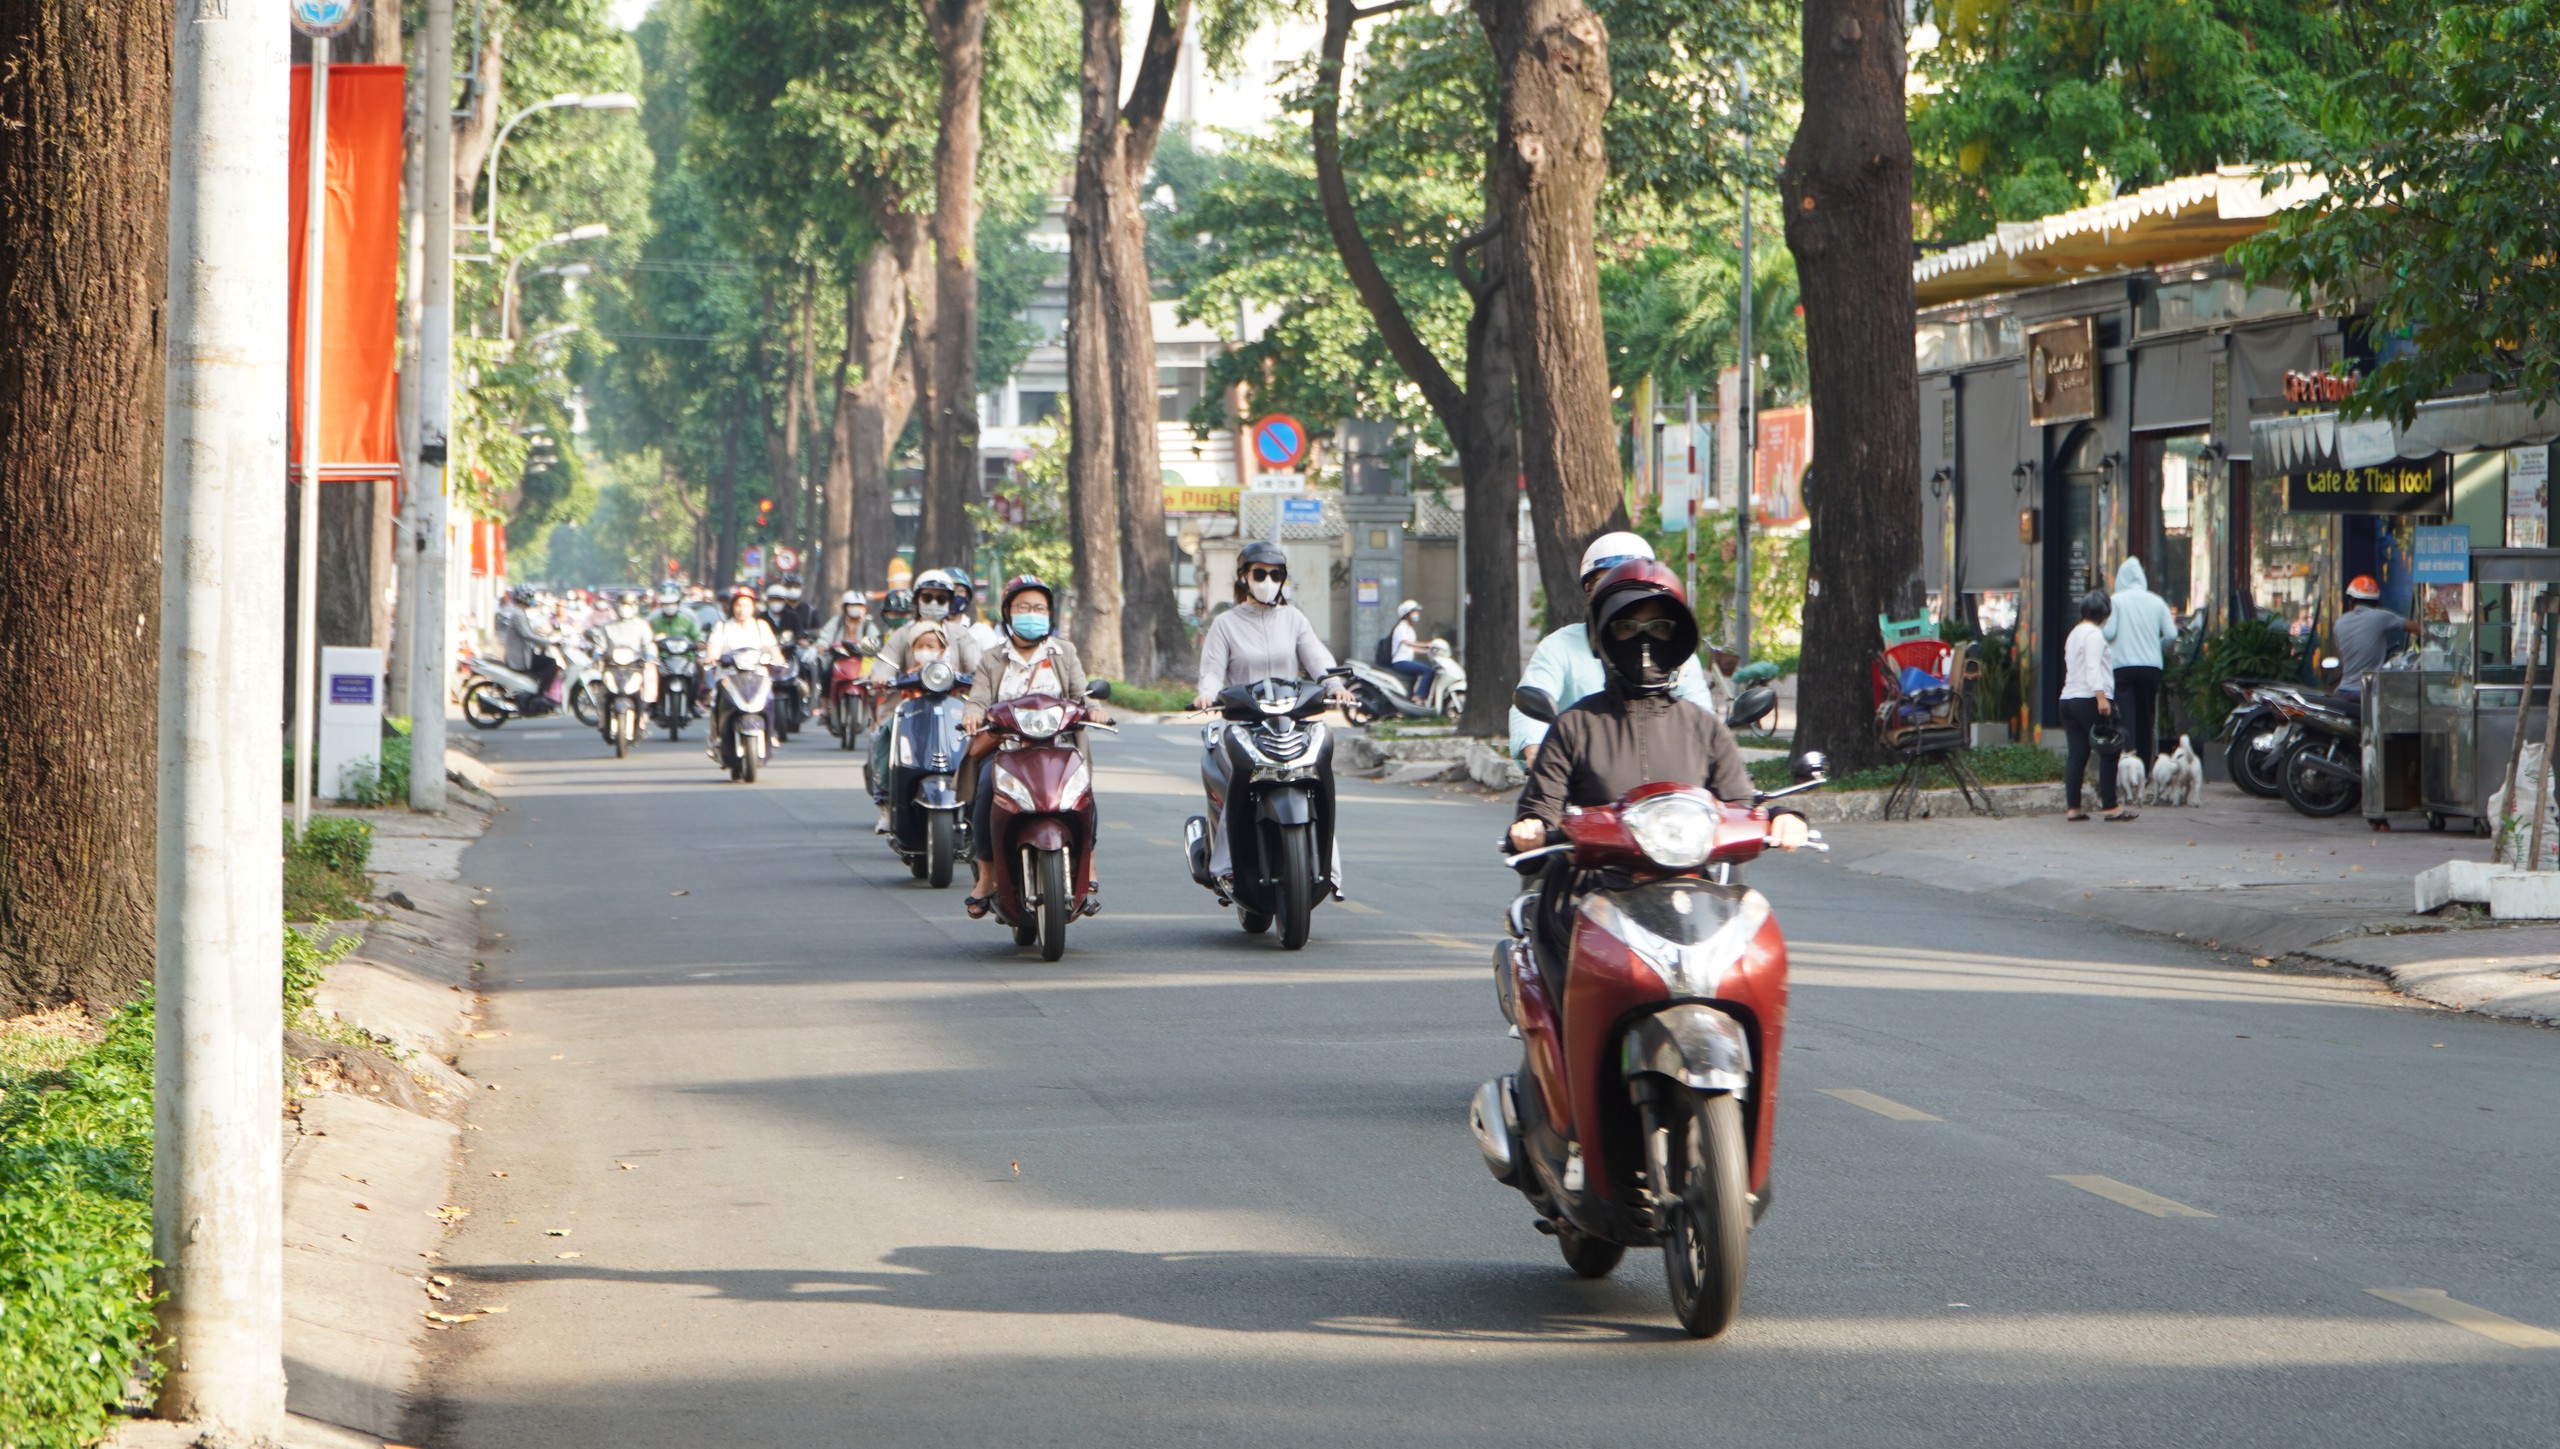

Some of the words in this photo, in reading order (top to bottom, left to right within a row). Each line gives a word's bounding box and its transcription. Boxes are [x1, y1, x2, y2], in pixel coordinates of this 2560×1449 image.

[2307, 470, 2342, 494] Cafe
[2344, 469, 2360, 493] &
[2364, 468, 2396, 493] Thai
[2399, 467, 2433, 494] food
